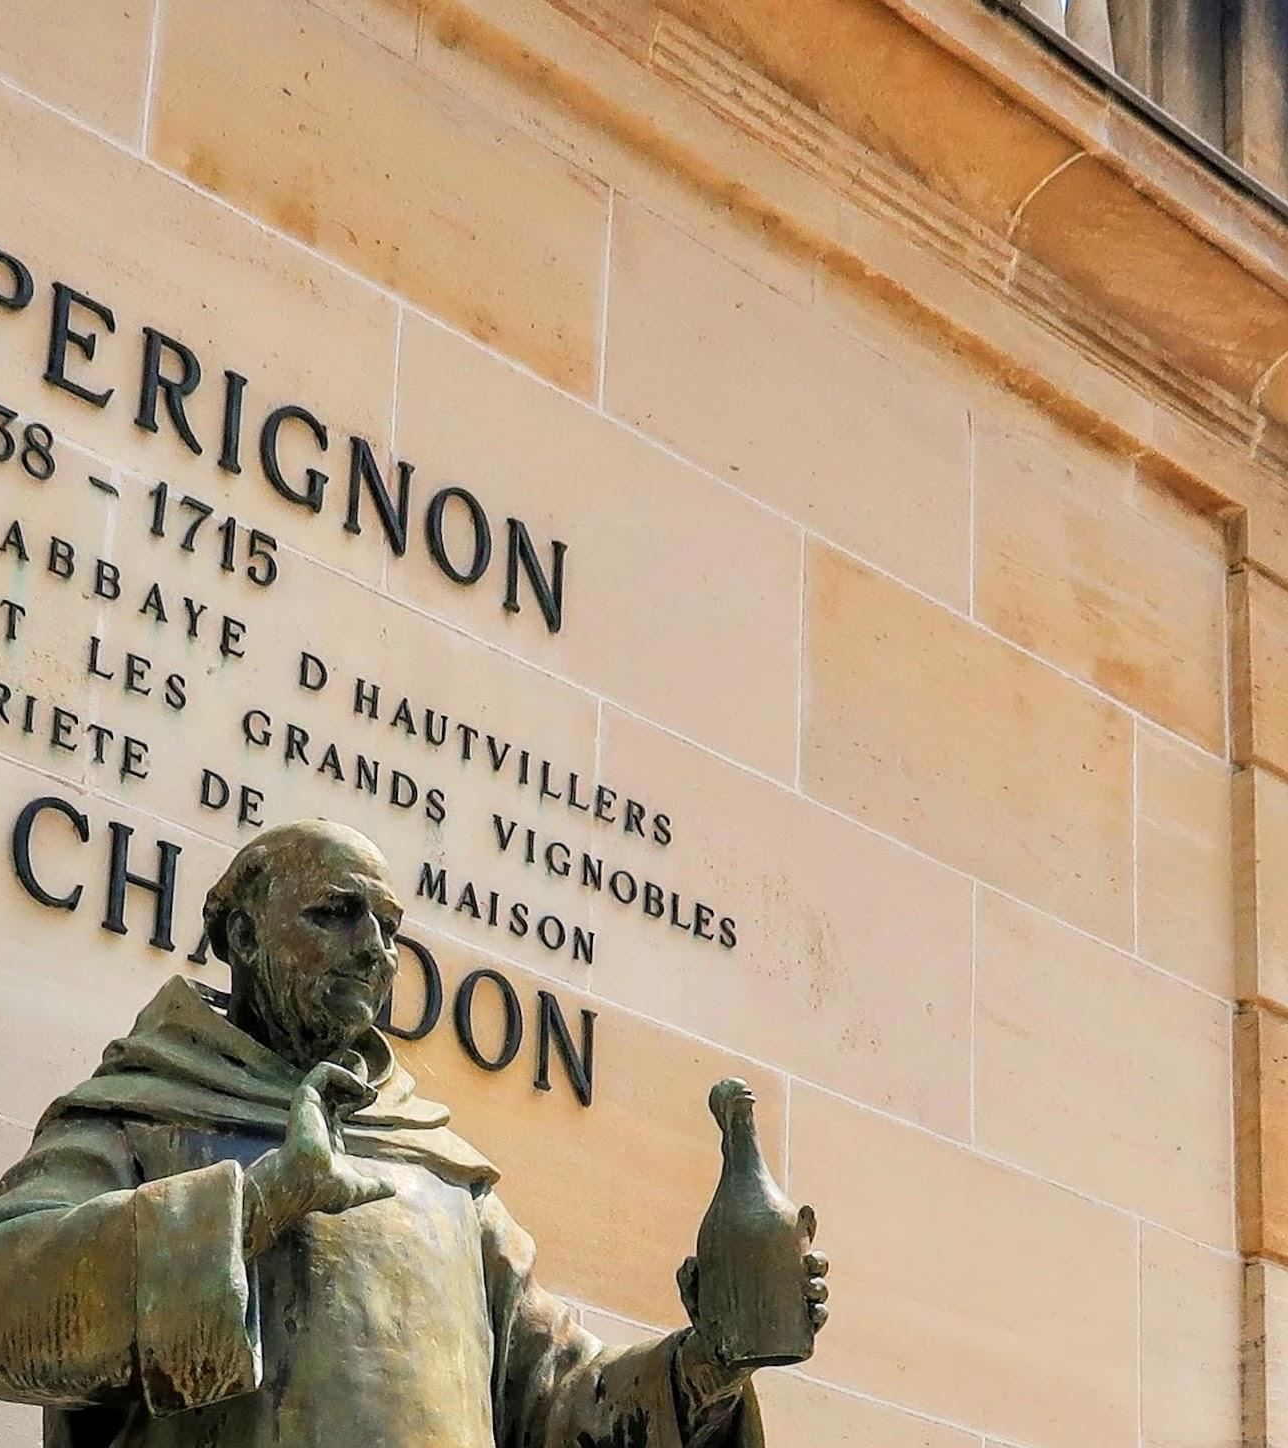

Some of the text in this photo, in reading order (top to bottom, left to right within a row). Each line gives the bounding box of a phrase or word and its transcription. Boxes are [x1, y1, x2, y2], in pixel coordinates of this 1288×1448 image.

[147, 480, 279, 589] 1715
[86, 634, 188, 712] LES
[240, 708, 447, 827] GRANDS
[491, 812, 738, 950] VIGNOBLES
[198, 767, 265, 829] DE
[415, 861, 596, 966] MAISON
[8, 795, 599, 1109] CHDON
